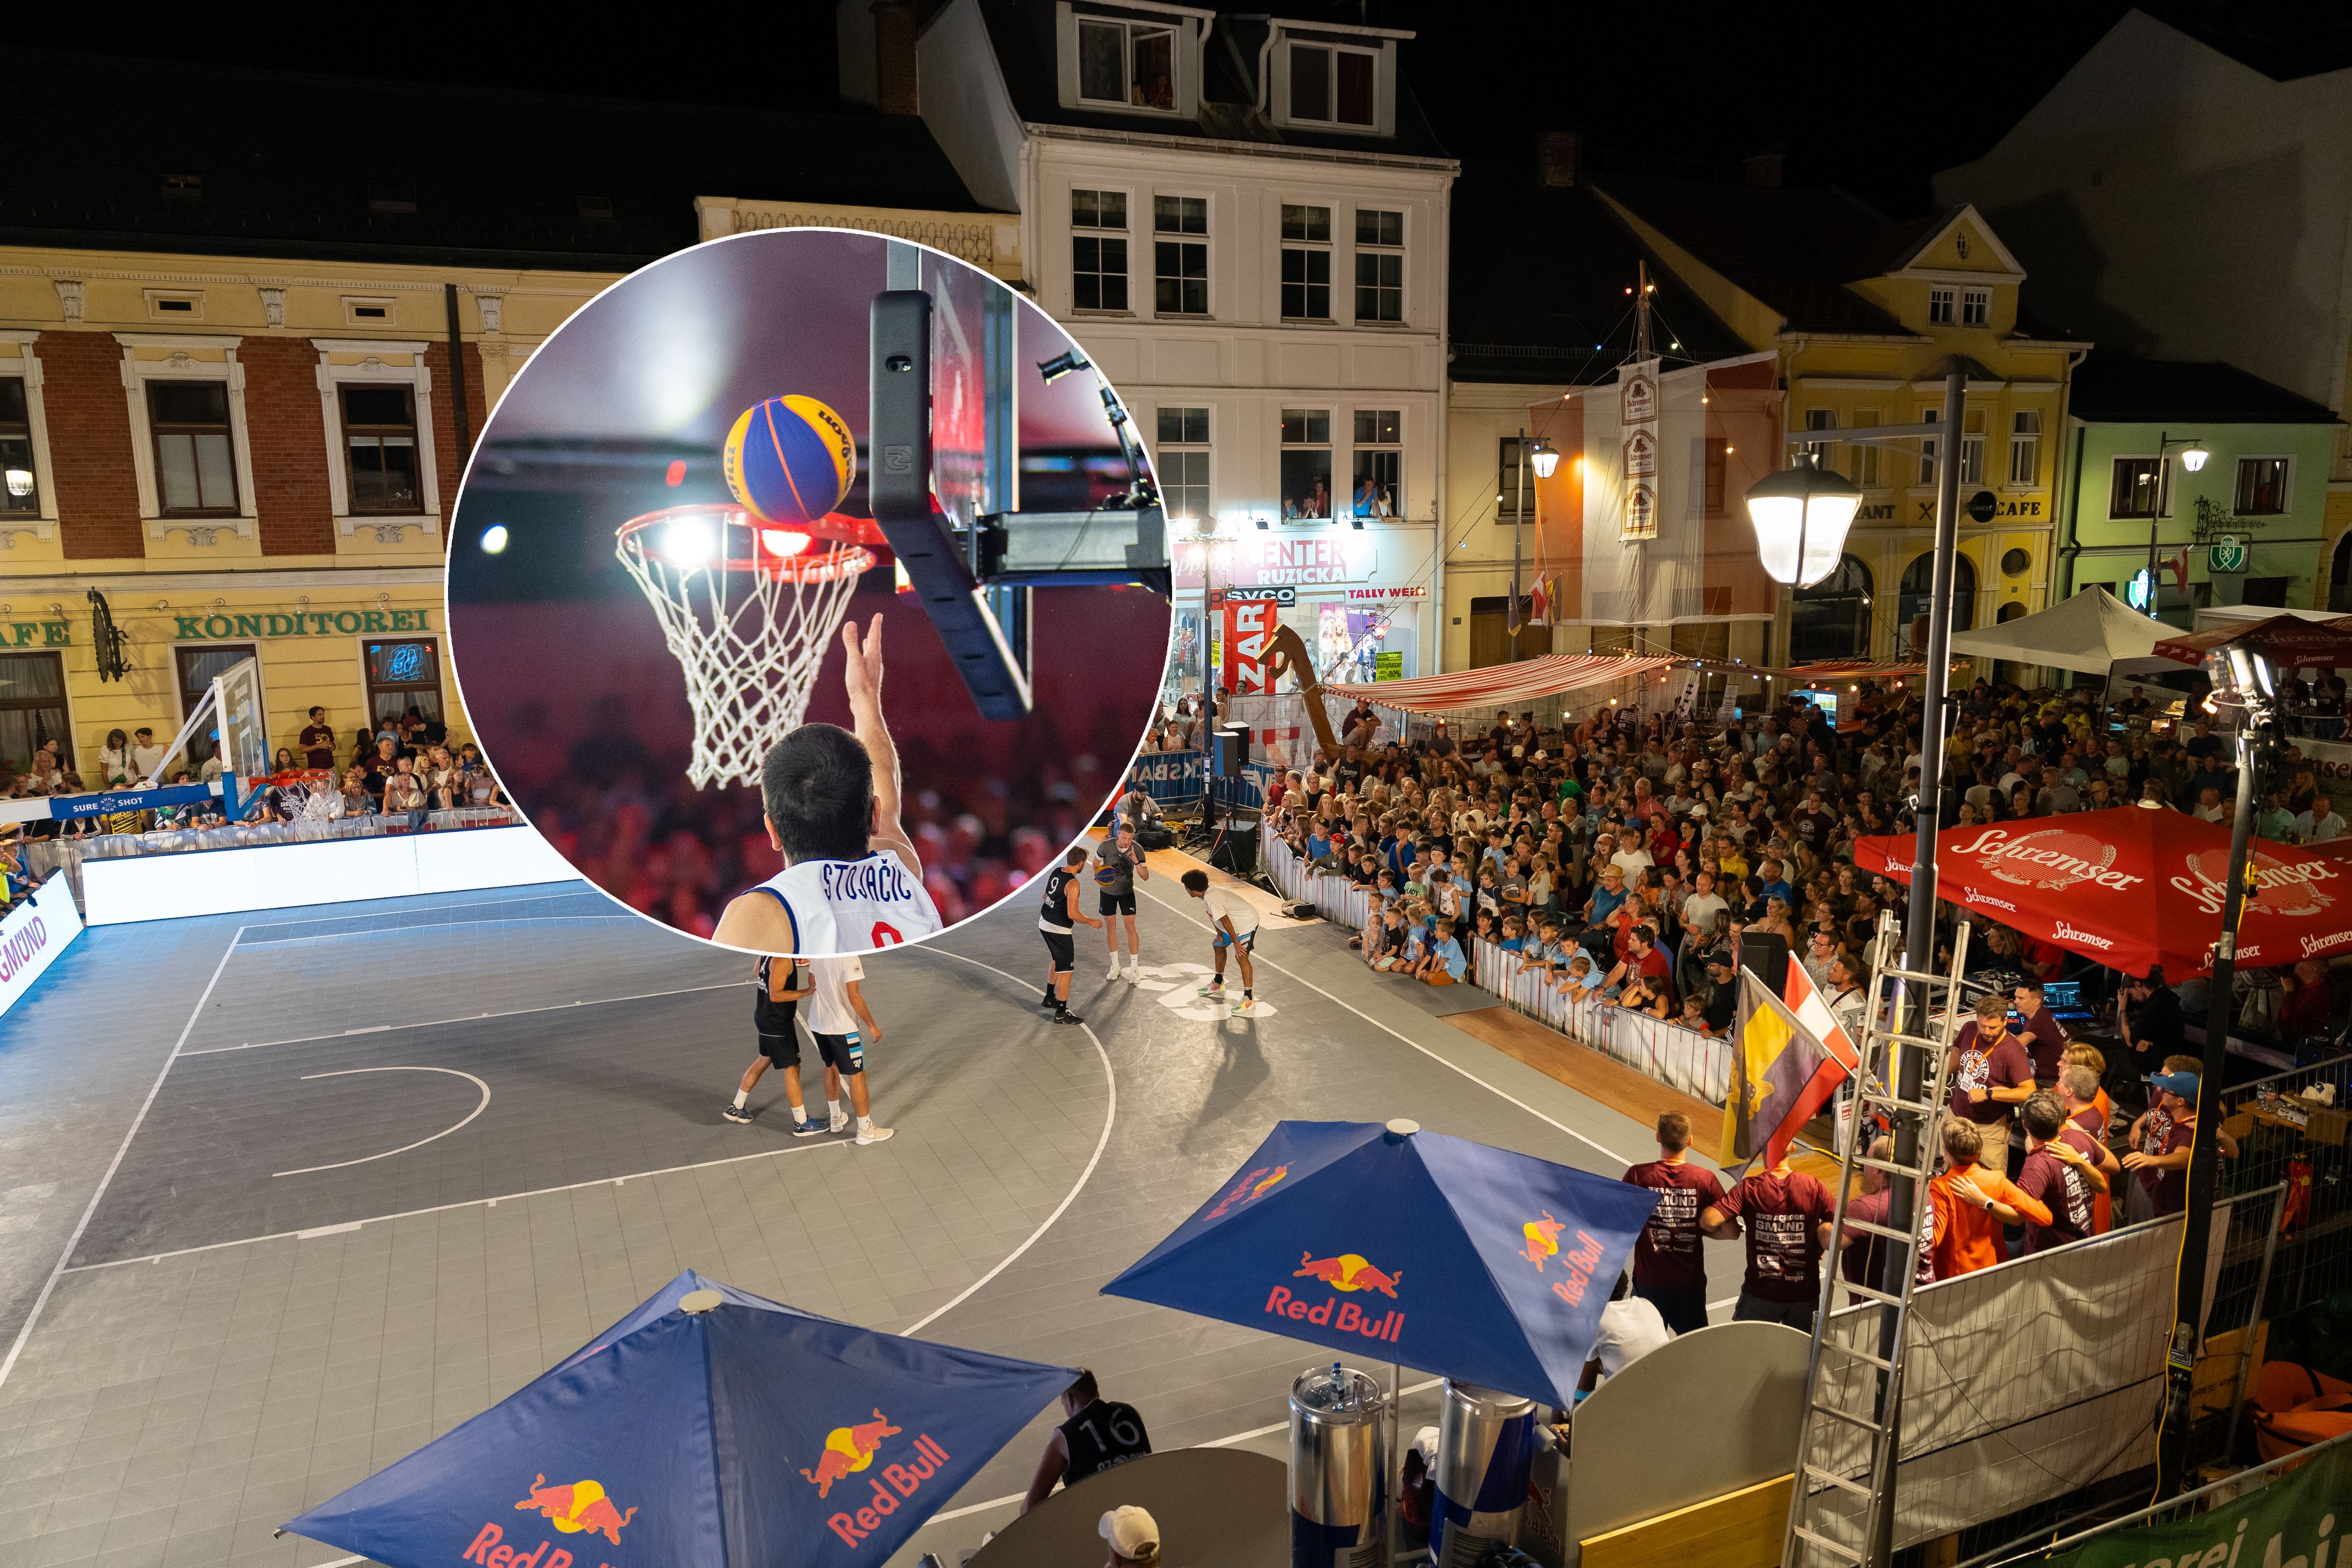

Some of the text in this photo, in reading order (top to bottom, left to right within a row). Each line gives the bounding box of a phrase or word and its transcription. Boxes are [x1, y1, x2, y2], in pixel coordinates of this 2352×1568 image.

[1627, 398, 1652, 407] Schremser
[1630, 453, 1653, 462] Schremser
[1629, 507, 1652, 515] Shremser
[1996, 502, 2041, 516] CAFE
[1257, 567, 1347, 585] RUZICKA
[1348, 588, 1385, 599] TALLY
[1917, 596, 1931, 604] HAUS
[173, 609, 430, 640] KONDITOREI
[1377, 661, 1402, 670] Billigbazar
[2294, 655, 2334, 665] Schremser
[1695, 791, 1700, 799] 8
[72, 797, 143, 813] SURE SHOT
[1950, 829, 2144, 891] Schremser
[1048, 877, 1059, 895] 9
[1964, 886, 2016, 912] Schremser
[2052, 921, 2113, 950] Schremser
[1658, 1193, 1698, 1207] MÜND
[1755, 1212, 1772, 1221] 3X3
[1755, 1219, 1805, 1232] GMÜND
[1758, 1233, 1802, 1242] 12.08.2023
[1552, 1229, 1605, 1308] Red Bull
[1785, 1274, 1804, 1282] berger
[1265, 1285, 1405, 1343] Red Bull
[1078, 1407, 1140, 1452] 16
[827, 1433, 951, 1549] Red Bull
